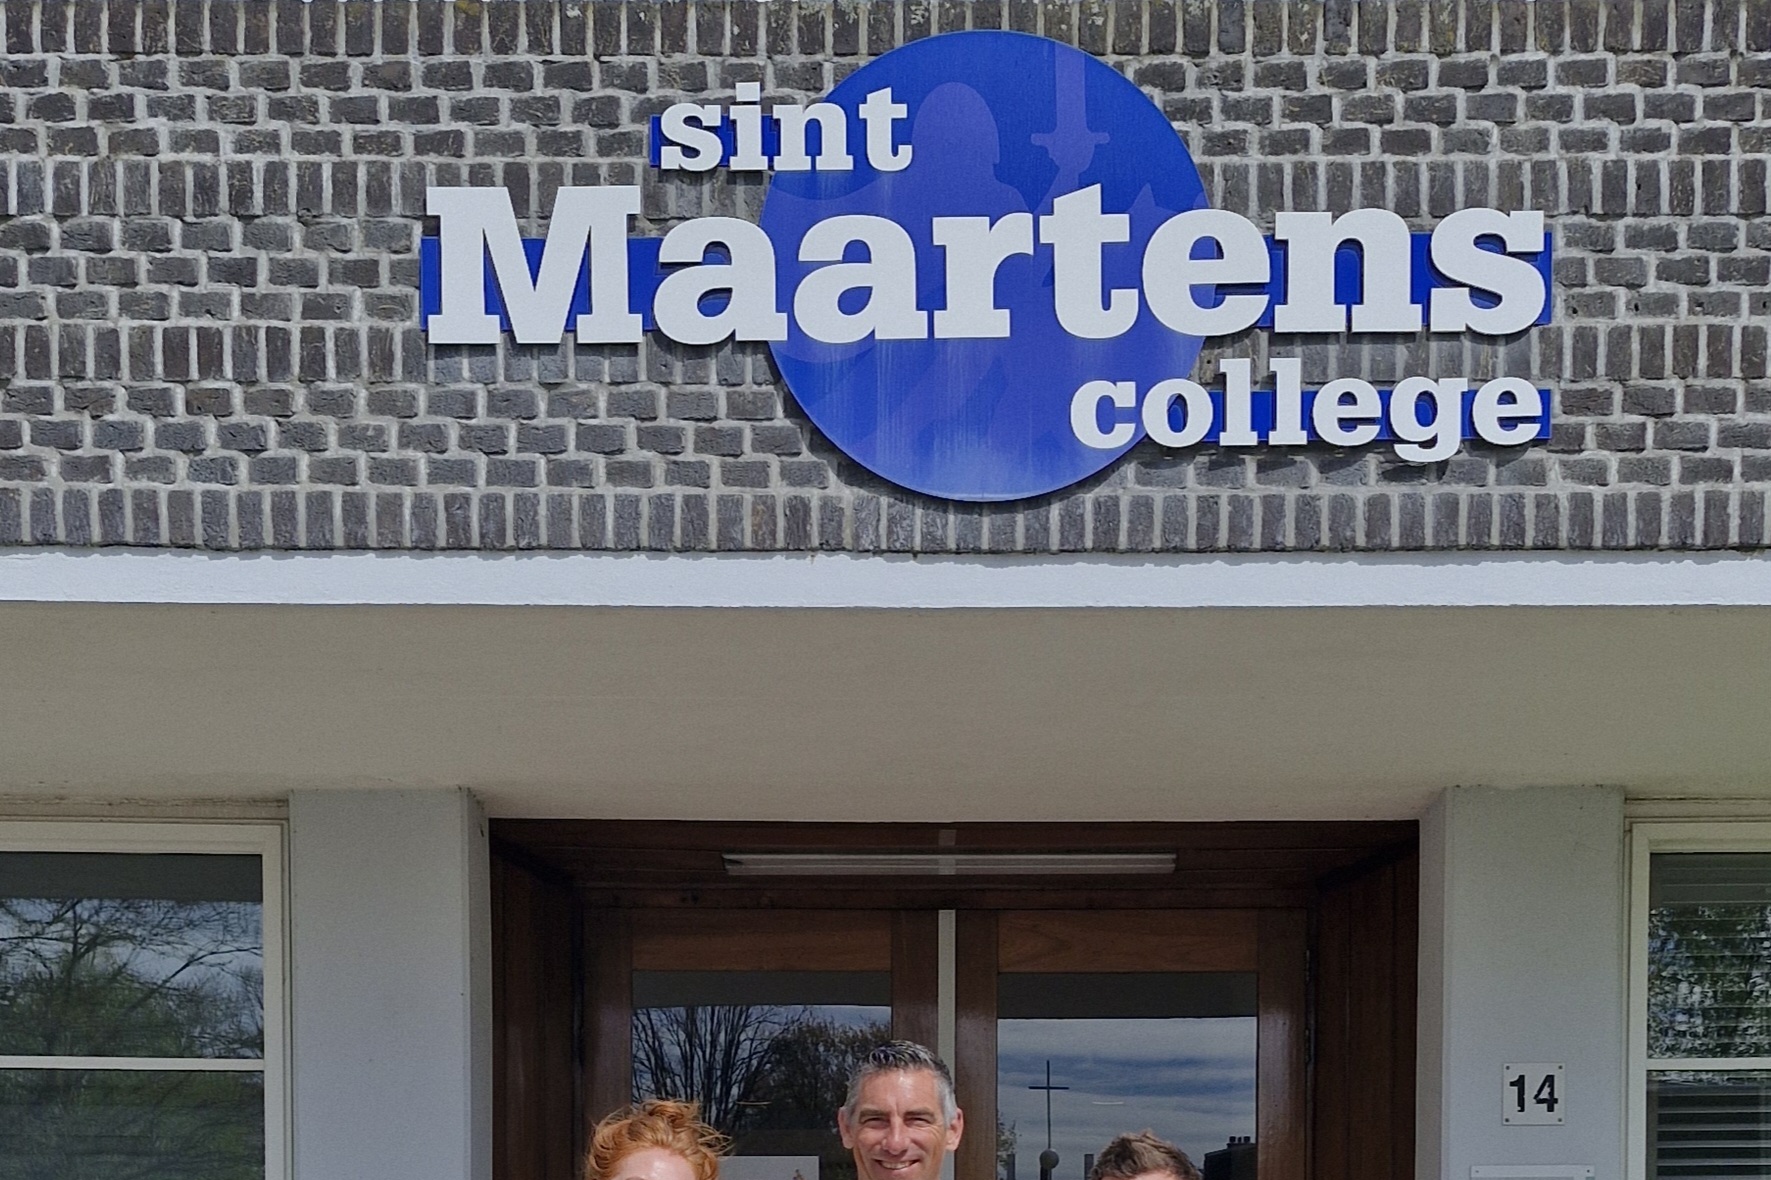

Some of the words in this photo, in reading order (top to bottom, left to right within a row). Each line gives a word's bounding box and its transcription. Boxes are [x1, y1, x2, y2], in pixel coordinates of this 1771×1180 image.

[658, 82, 913, 173] sint
[426, 183, 1547, 346] Maartens
[1070, 357, 1544, 462] college
[1509, 1074, 1559, 1113] 14
